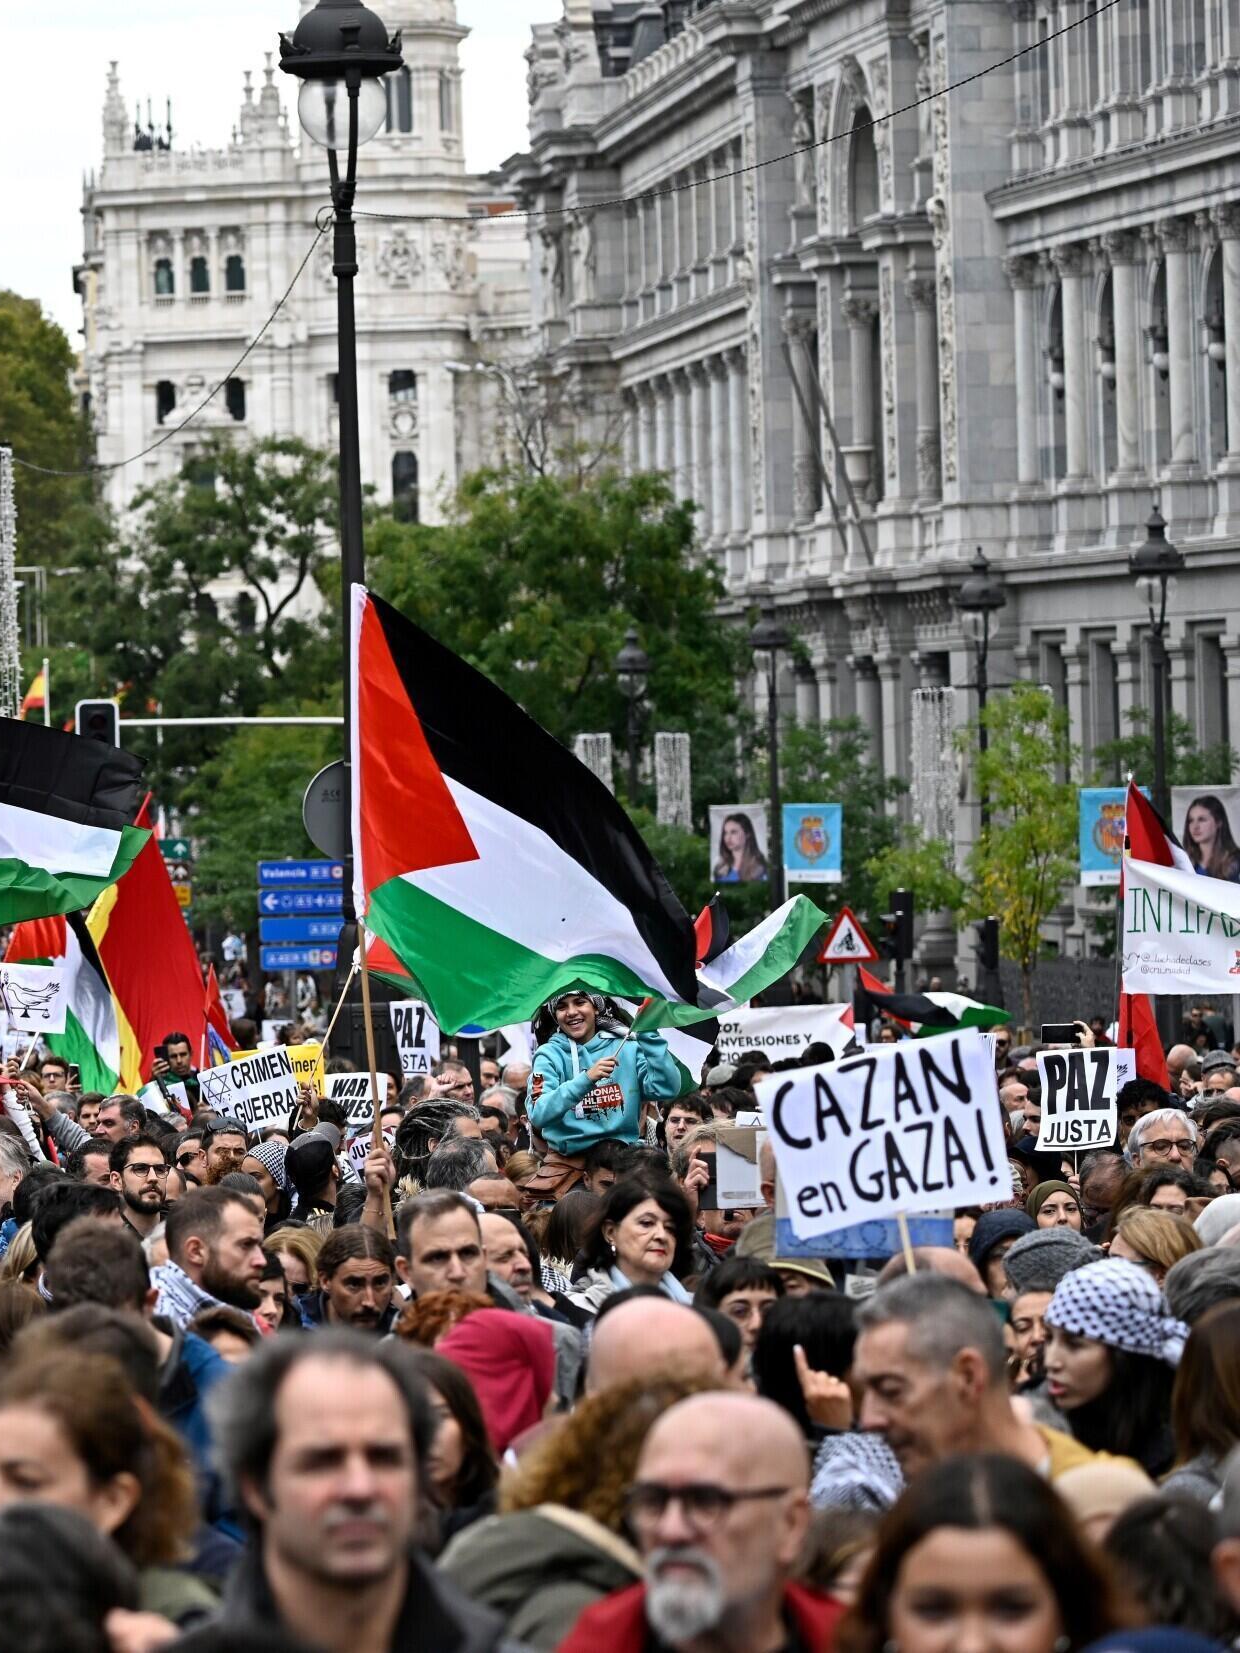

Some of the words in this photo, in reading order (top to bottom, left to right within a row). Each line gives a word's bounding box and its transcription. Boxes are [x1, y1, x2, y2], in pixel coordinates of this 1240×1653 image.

[394, 1007, 426, 1048] PAZ
[803, 1033, 813, 1044] Y
[231, 1050, 292, 1089] CRIMEN
[331, 1078, 369, 1098] WAR
[1043, 1050, 1111, 1115] PAZ
[772, 1039, 972, 1149] CAZAN
[1043, 1119, 1112, 1144] JUSTA
[796, 1181, 848, 1217] en
[848, 1108, 998, 1203] GAZA!
